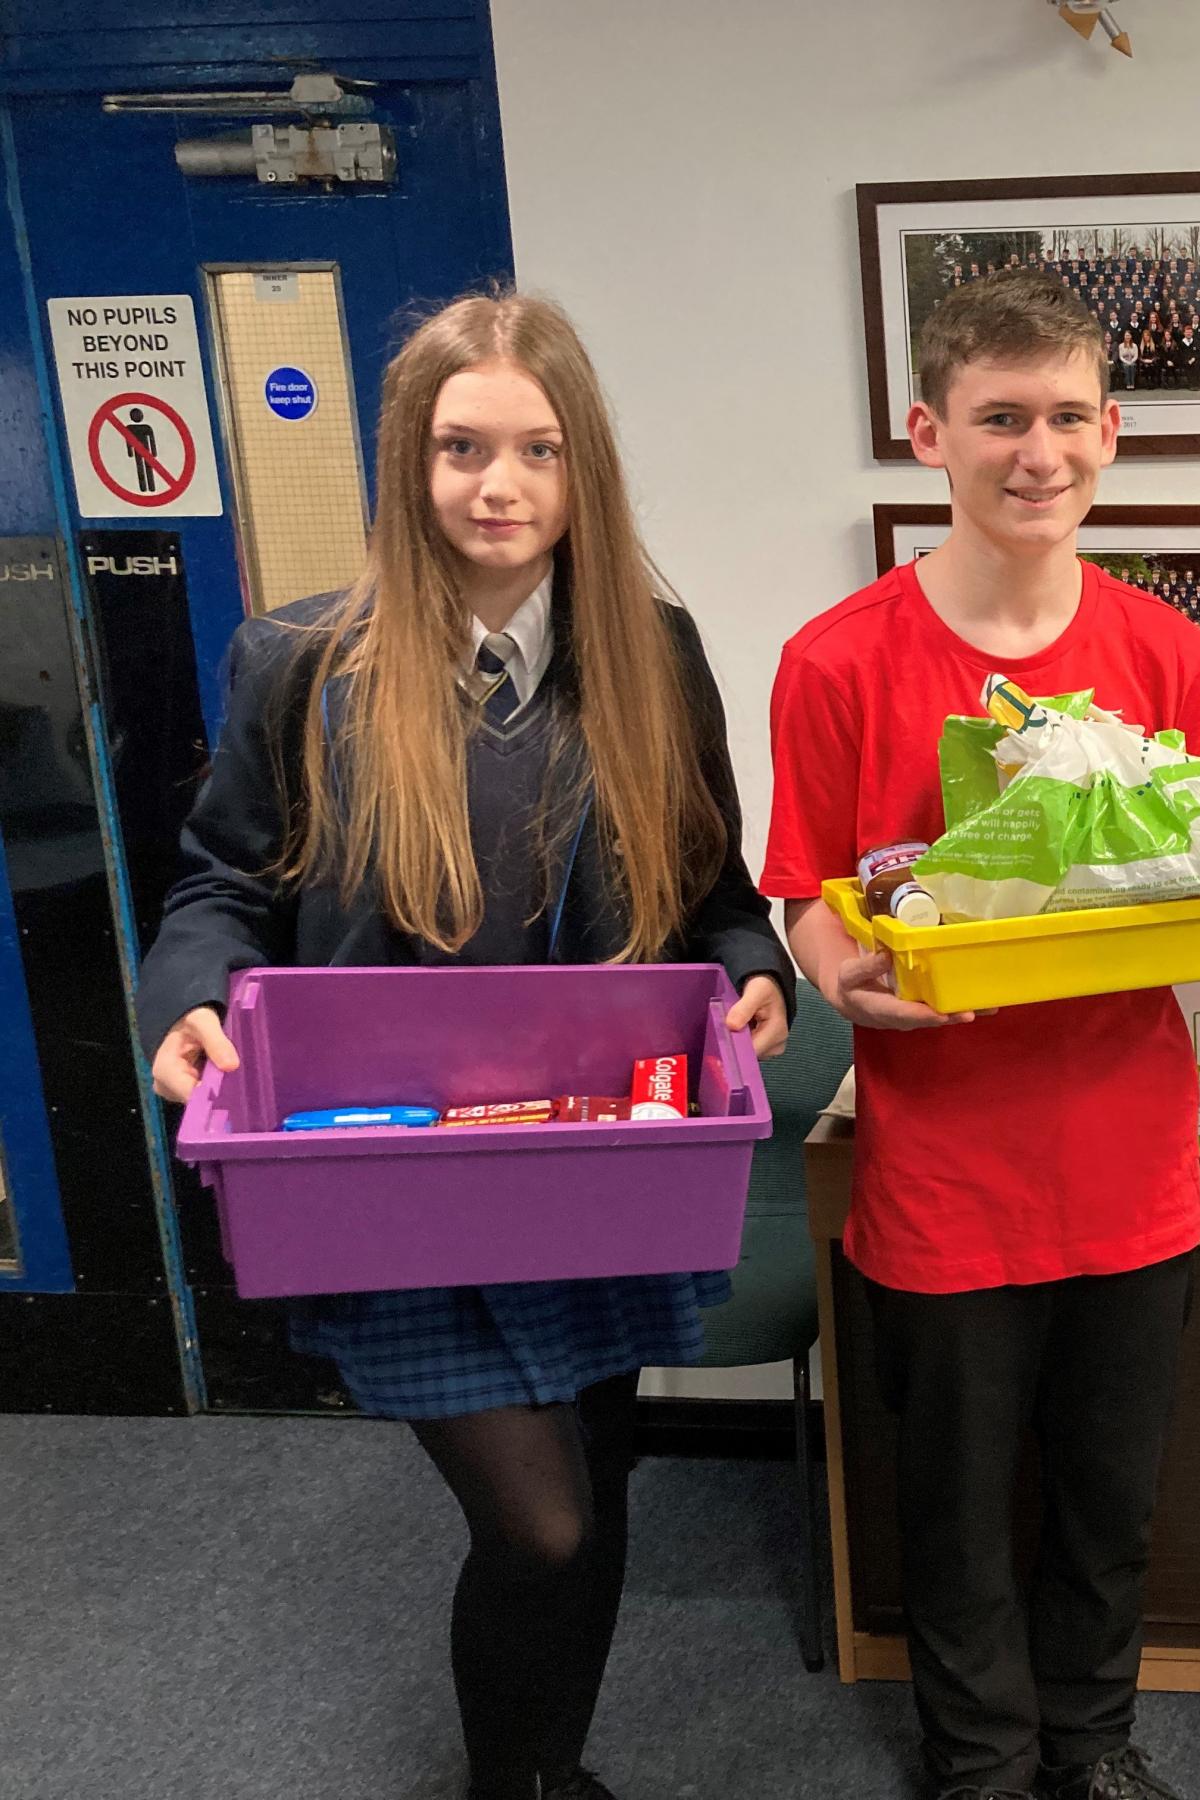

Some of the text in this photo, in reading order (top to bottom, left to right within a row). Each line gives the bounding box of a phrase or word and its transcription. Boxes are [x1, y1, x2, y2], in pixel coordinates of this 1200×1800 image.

[67, 307, 177, 326] NO PUPILS
[83, 334, 168, 352] BEYOND
[72, 360, 186, 379] THIS POINT
[269, 382, 309, 391] Fire door
[269, 395, 312, 405] keep shut
[88, 556, 178, 576] PUSH
[1002, 808, 1014, 817] or
[1017, 808, 1040, 819] gets
[981, 819, 1001, 829] will
[1002, 819, 1041, 831] happily
[960, 829, 980, 839] free
[983, 831, 995, 841] of
[648, 1056, 678, 1102] Colgate
